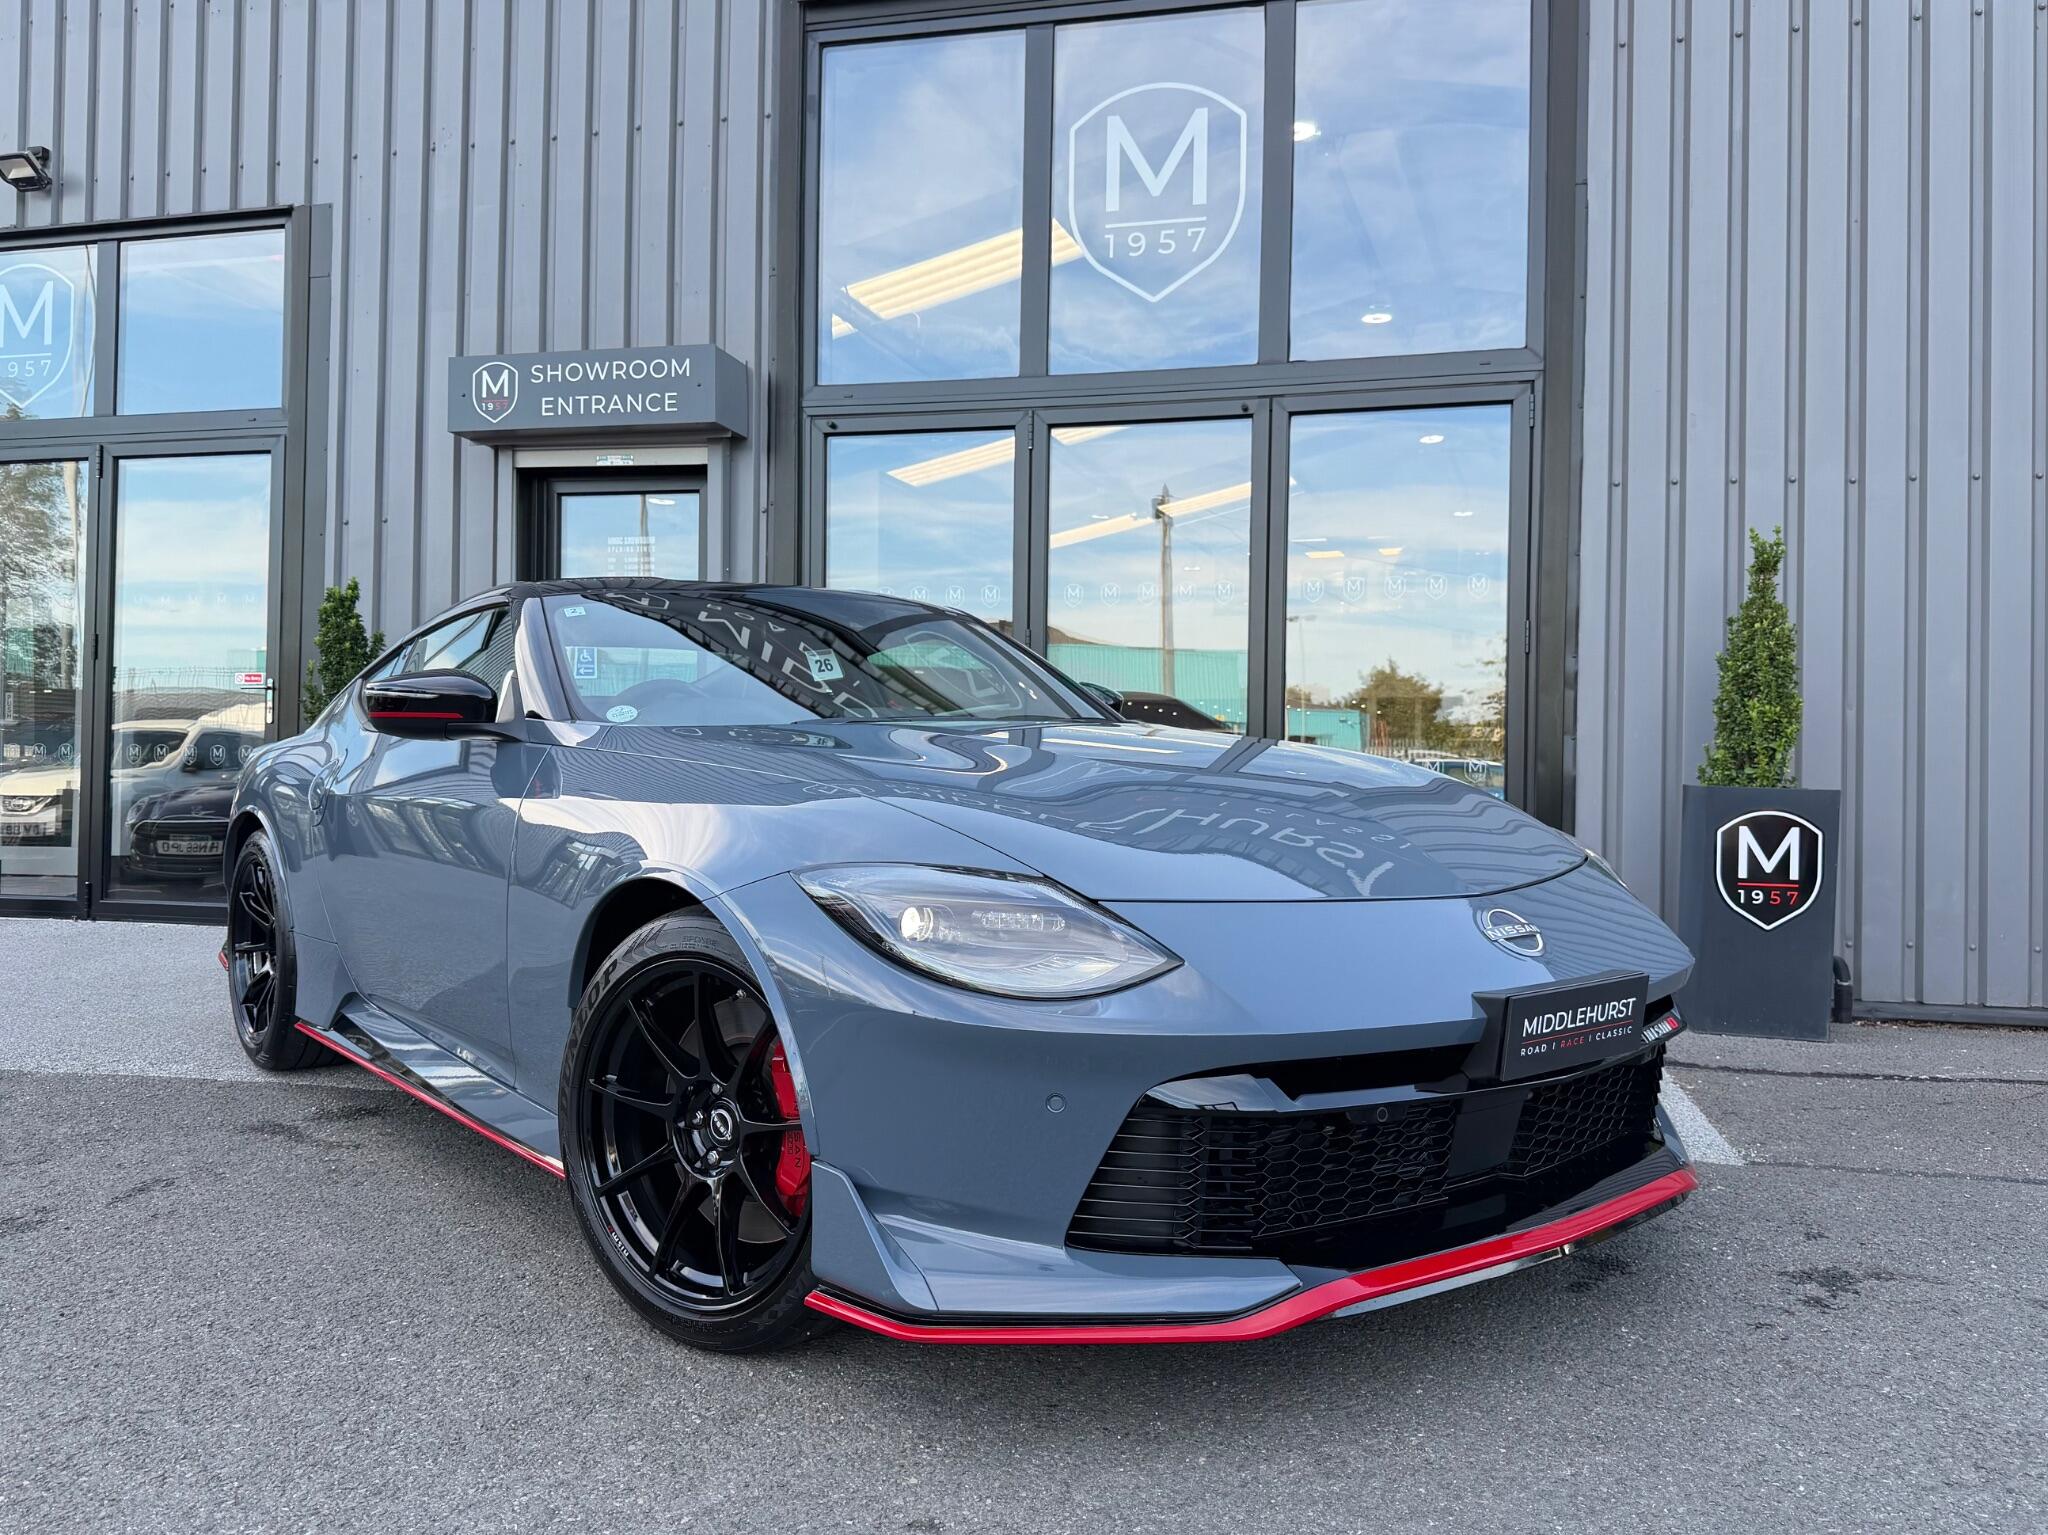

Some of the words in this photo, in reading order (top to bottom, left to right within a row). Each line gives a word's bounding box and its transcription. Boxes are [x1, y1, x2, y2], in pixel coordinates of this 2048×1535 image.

[1105, 107, 1209, 213] M
[1104, 227, 1207, 259] 1957
[0, 280, 54, 348] M
[7, 359, 52, 378] 957
[530, 358, 690, 384] SHOWROOM
[481, 369, 510, 399] M
[481, 401, 509, 412] 1957
[541, 392, 679, 417] ENTRANCE
[815, 658, 834, 673] 26
[1738, 826, 1800, 880] M
[1738, 889, 1799, 905] 1957
[1487, 921, 1541, 942] NISSAN
[1522, 998, 1637, 1038] MIDDLEHURST
[1520, 1043, 1548, 1057] ROAD
[1560, 1035, 1586, 1049] RACE
[1595, 1026, 1634, 1042] CLASSIC
